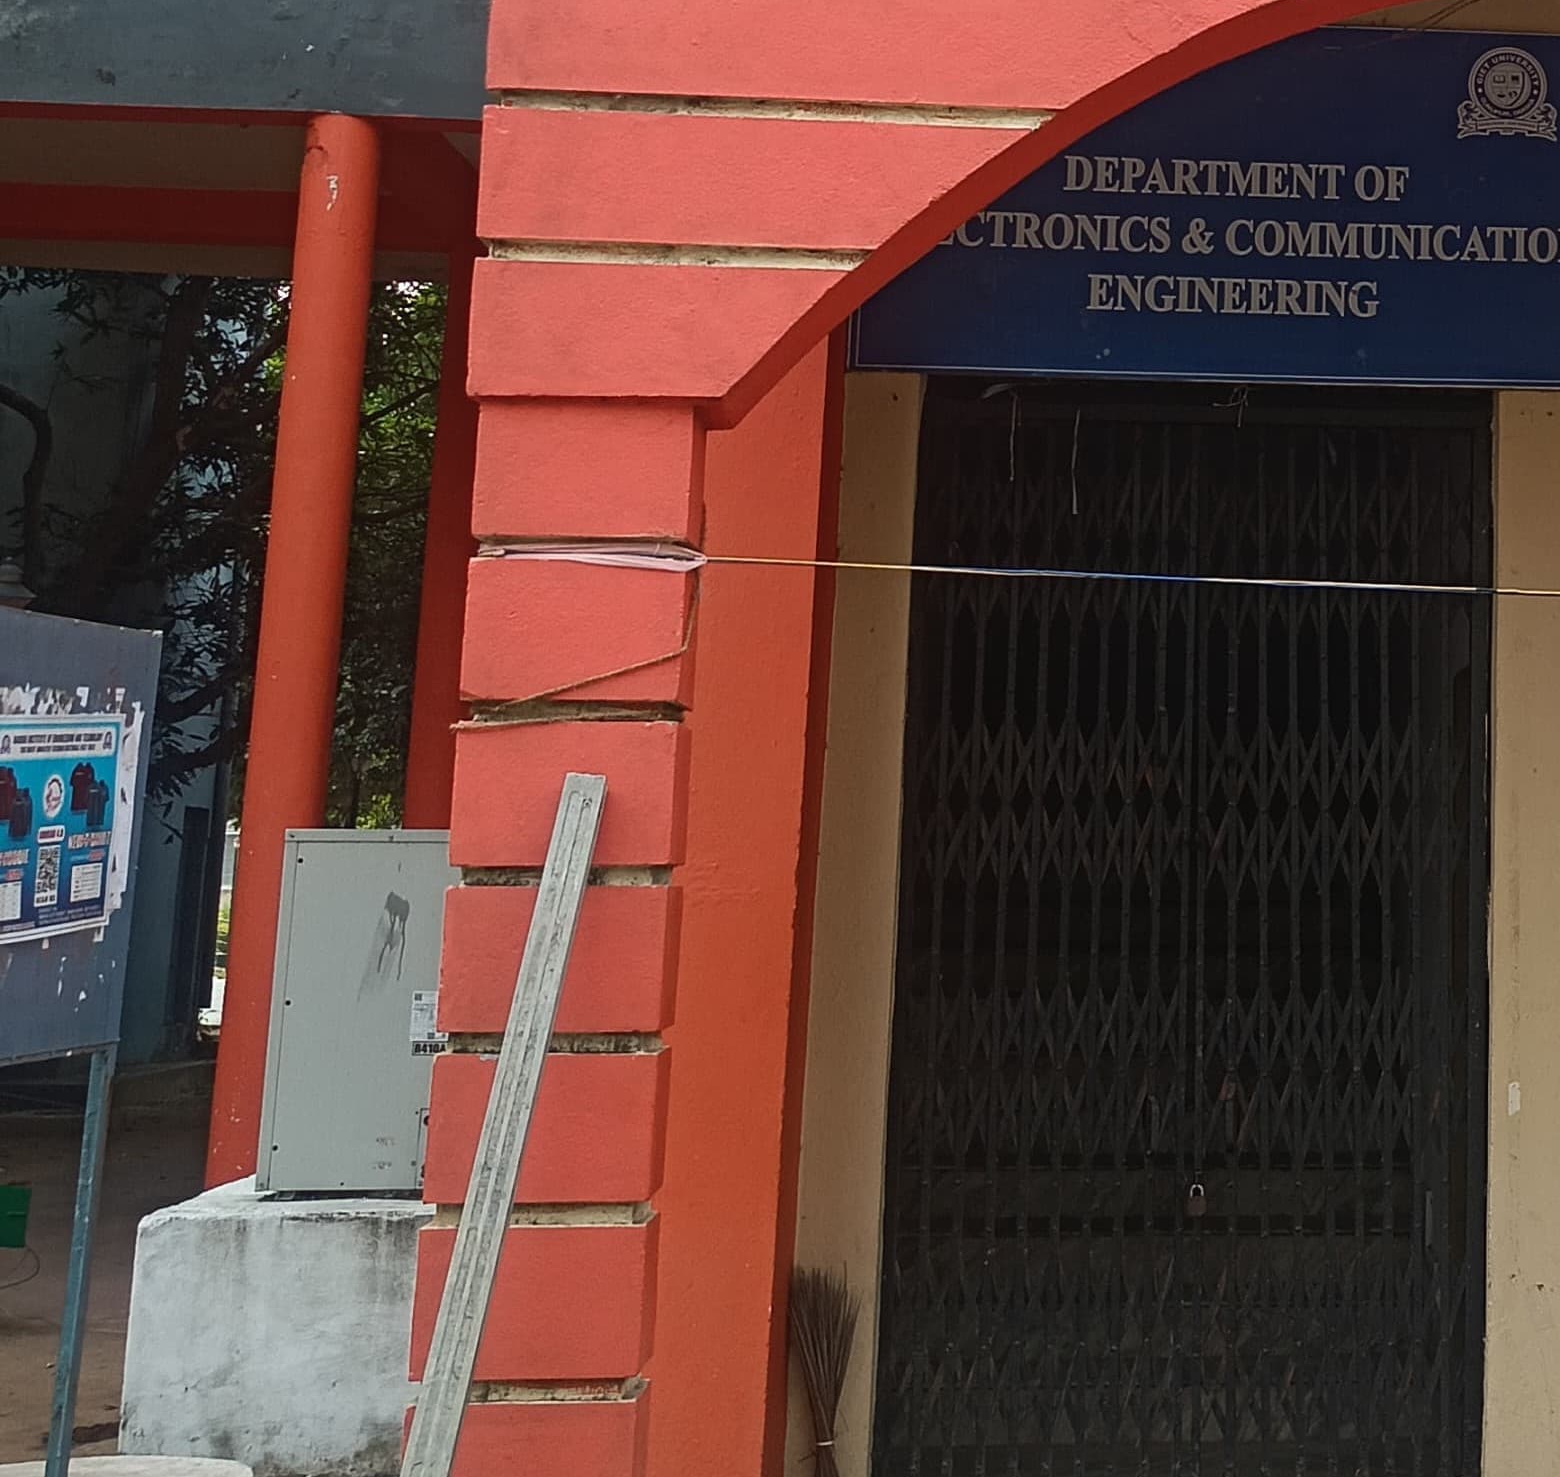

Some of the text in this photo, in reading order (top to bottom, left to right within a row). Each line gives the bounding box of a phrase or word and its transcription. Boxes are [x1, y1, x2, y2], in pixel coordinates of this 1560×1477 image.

[1063, 154, 1409, 202] DEPARTMENT OF
[1181, 217, 1215, 255] &
[1086, 274, 1380, 318] ENGINEERING
